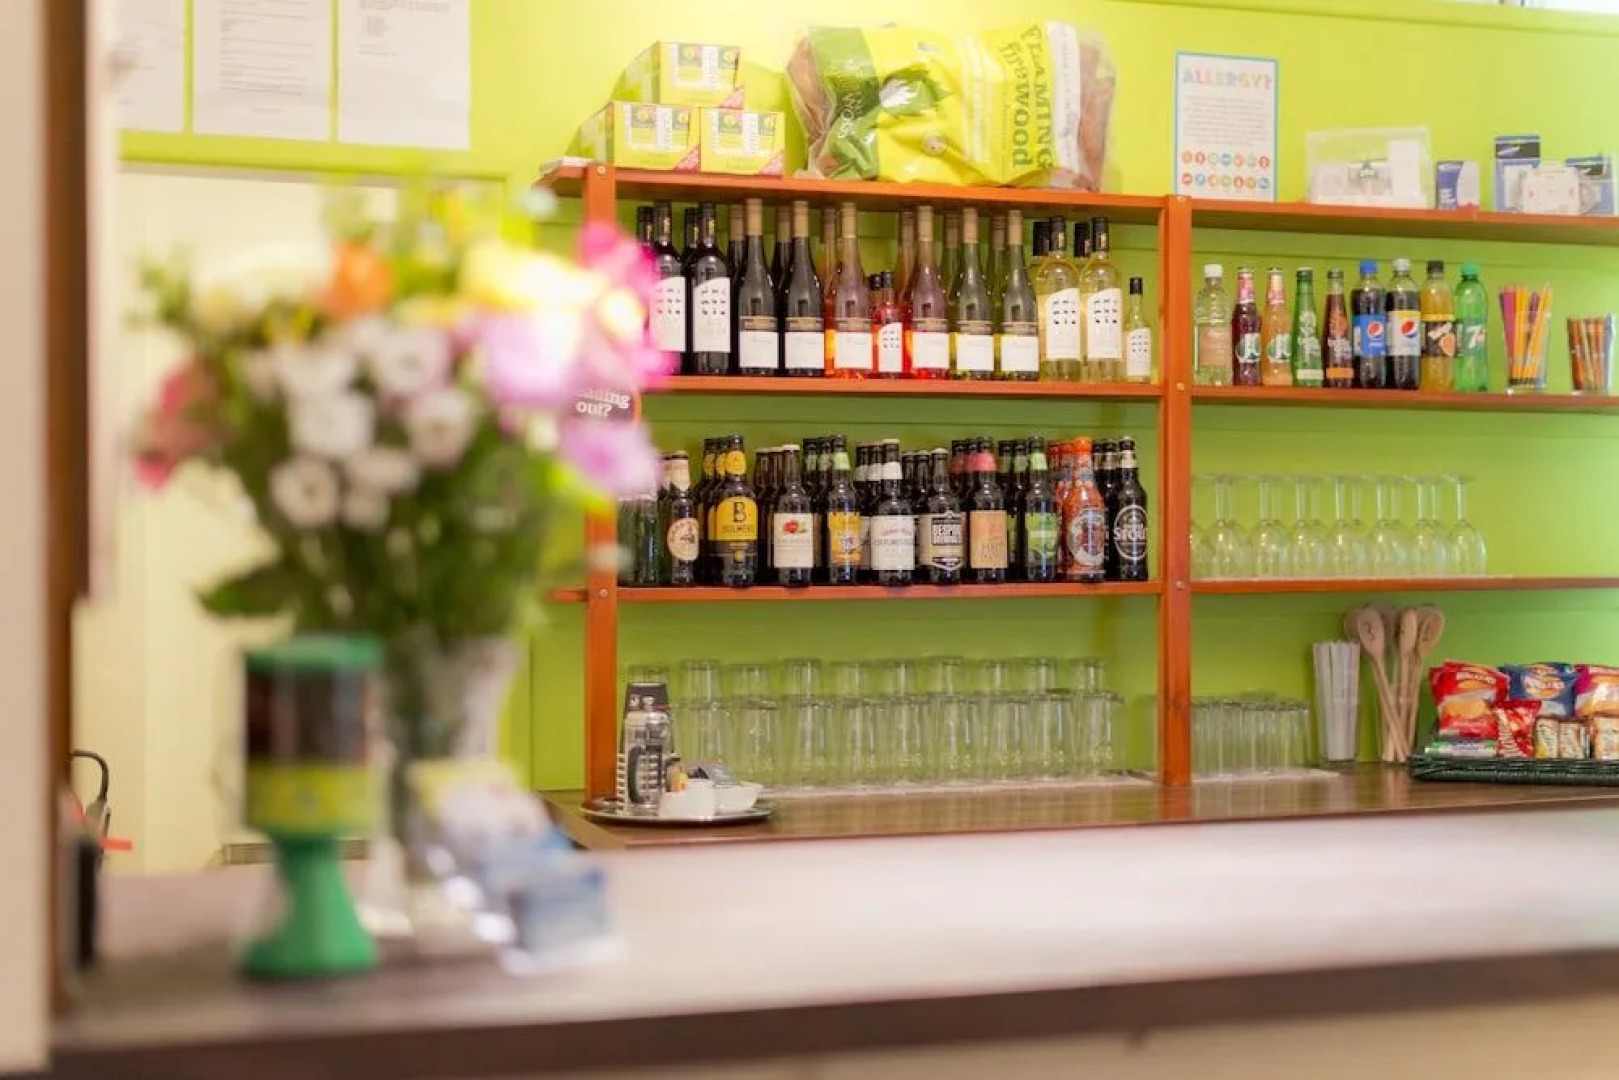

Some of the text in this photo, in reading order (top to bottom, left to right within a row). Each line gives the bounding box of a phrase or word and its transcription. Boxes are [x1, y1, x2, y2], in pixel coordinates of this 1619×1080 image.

[1182, 68, 1272, 90] ALLERGY?
[999, 41, 1034, 168] firewood
[1021, 24, 1053, 171] FLAMING
[575, 401, 613, 417] out?
[732, 501, 747, 523] B
